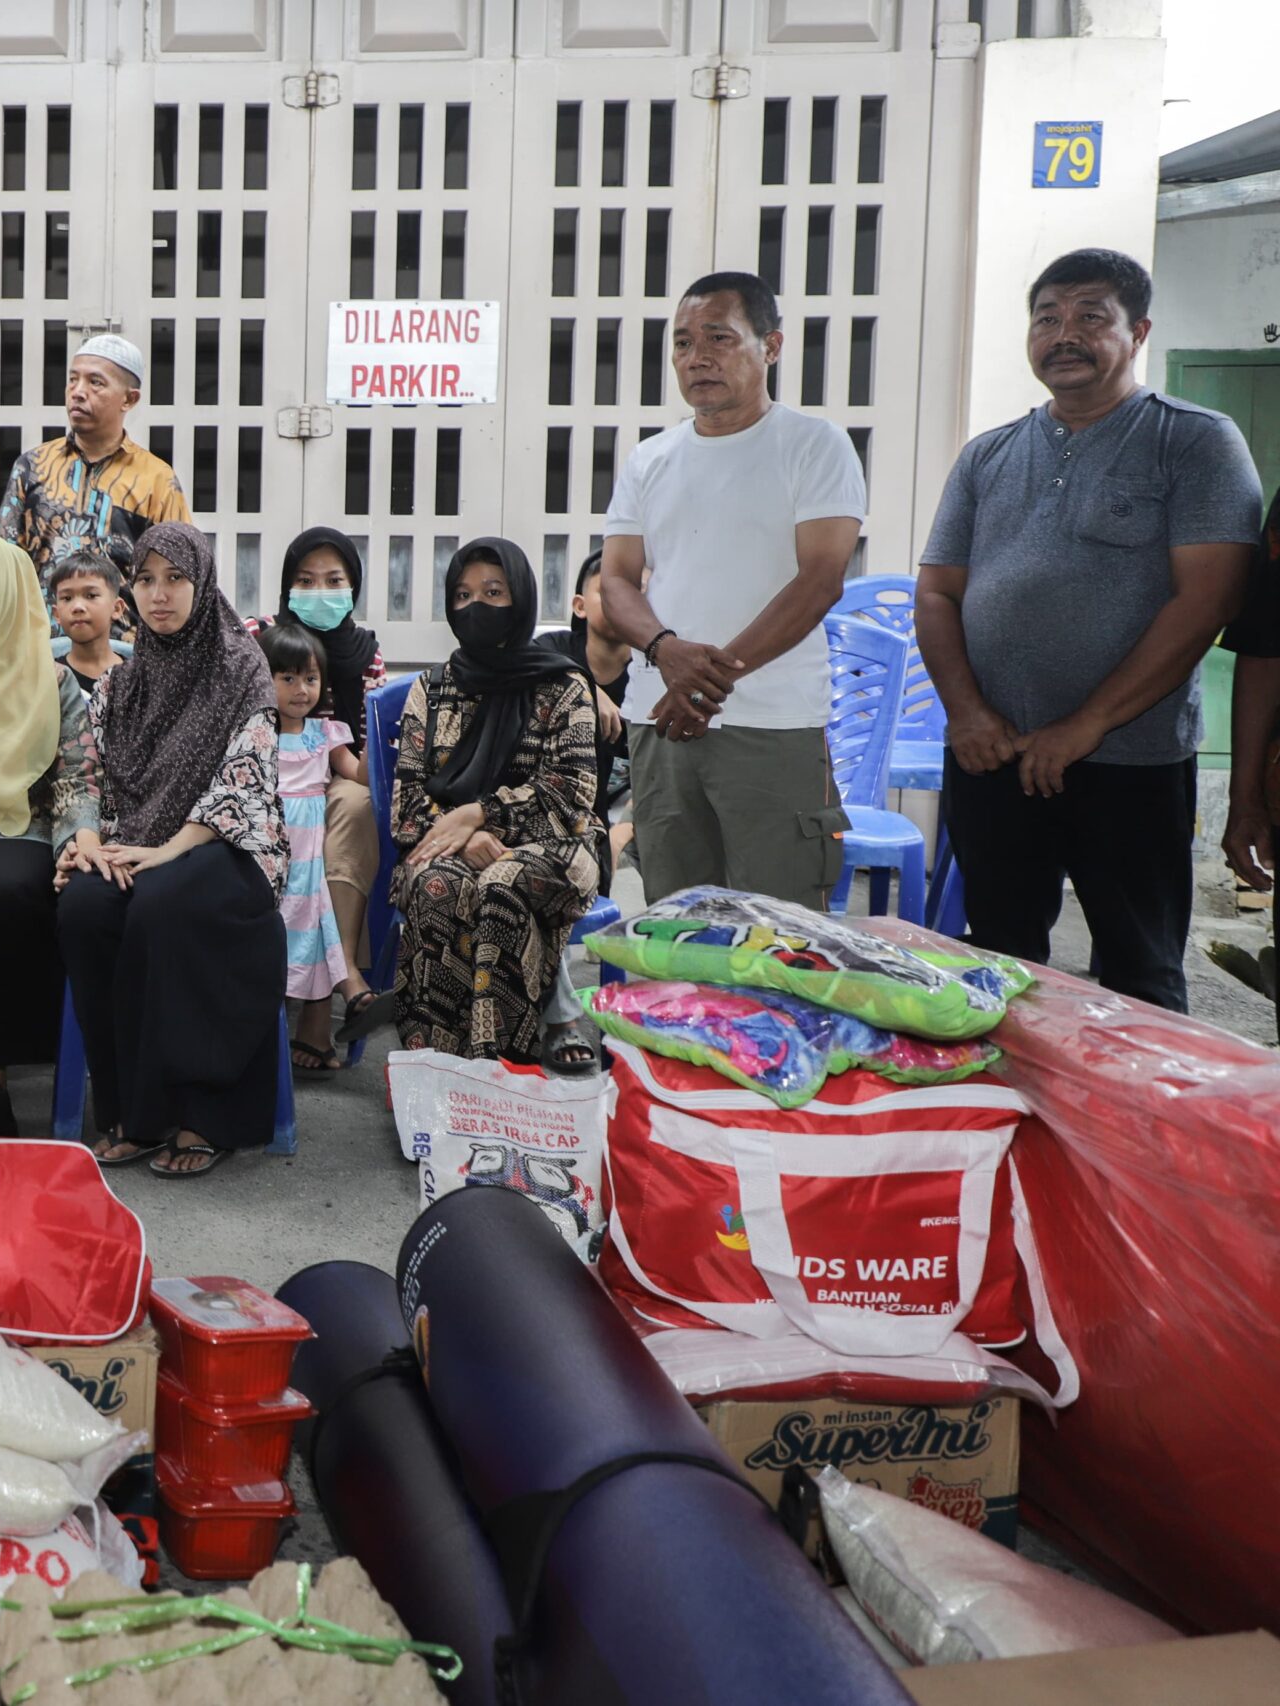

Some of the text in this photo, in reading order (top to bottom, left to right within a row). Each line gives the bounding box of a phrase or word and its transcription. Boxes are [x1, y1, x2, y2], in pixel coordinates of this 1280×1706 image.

[1044, 136, 1095, 182] 79
[345, 309, 481, 344] DILARANG
[450, 1115, 502, 1134] BERAS
[545, 1133, 581, 1149] CAP
[856, 1256, 948, 1281] WARE
[817, 1289, 901, 1304] BANTUAN
[878, 1303, 937, 1314] SOSIAL
[824, 1409, 892, 1425] mi instan
[924, 1481, 978, 1501] Kreasi
